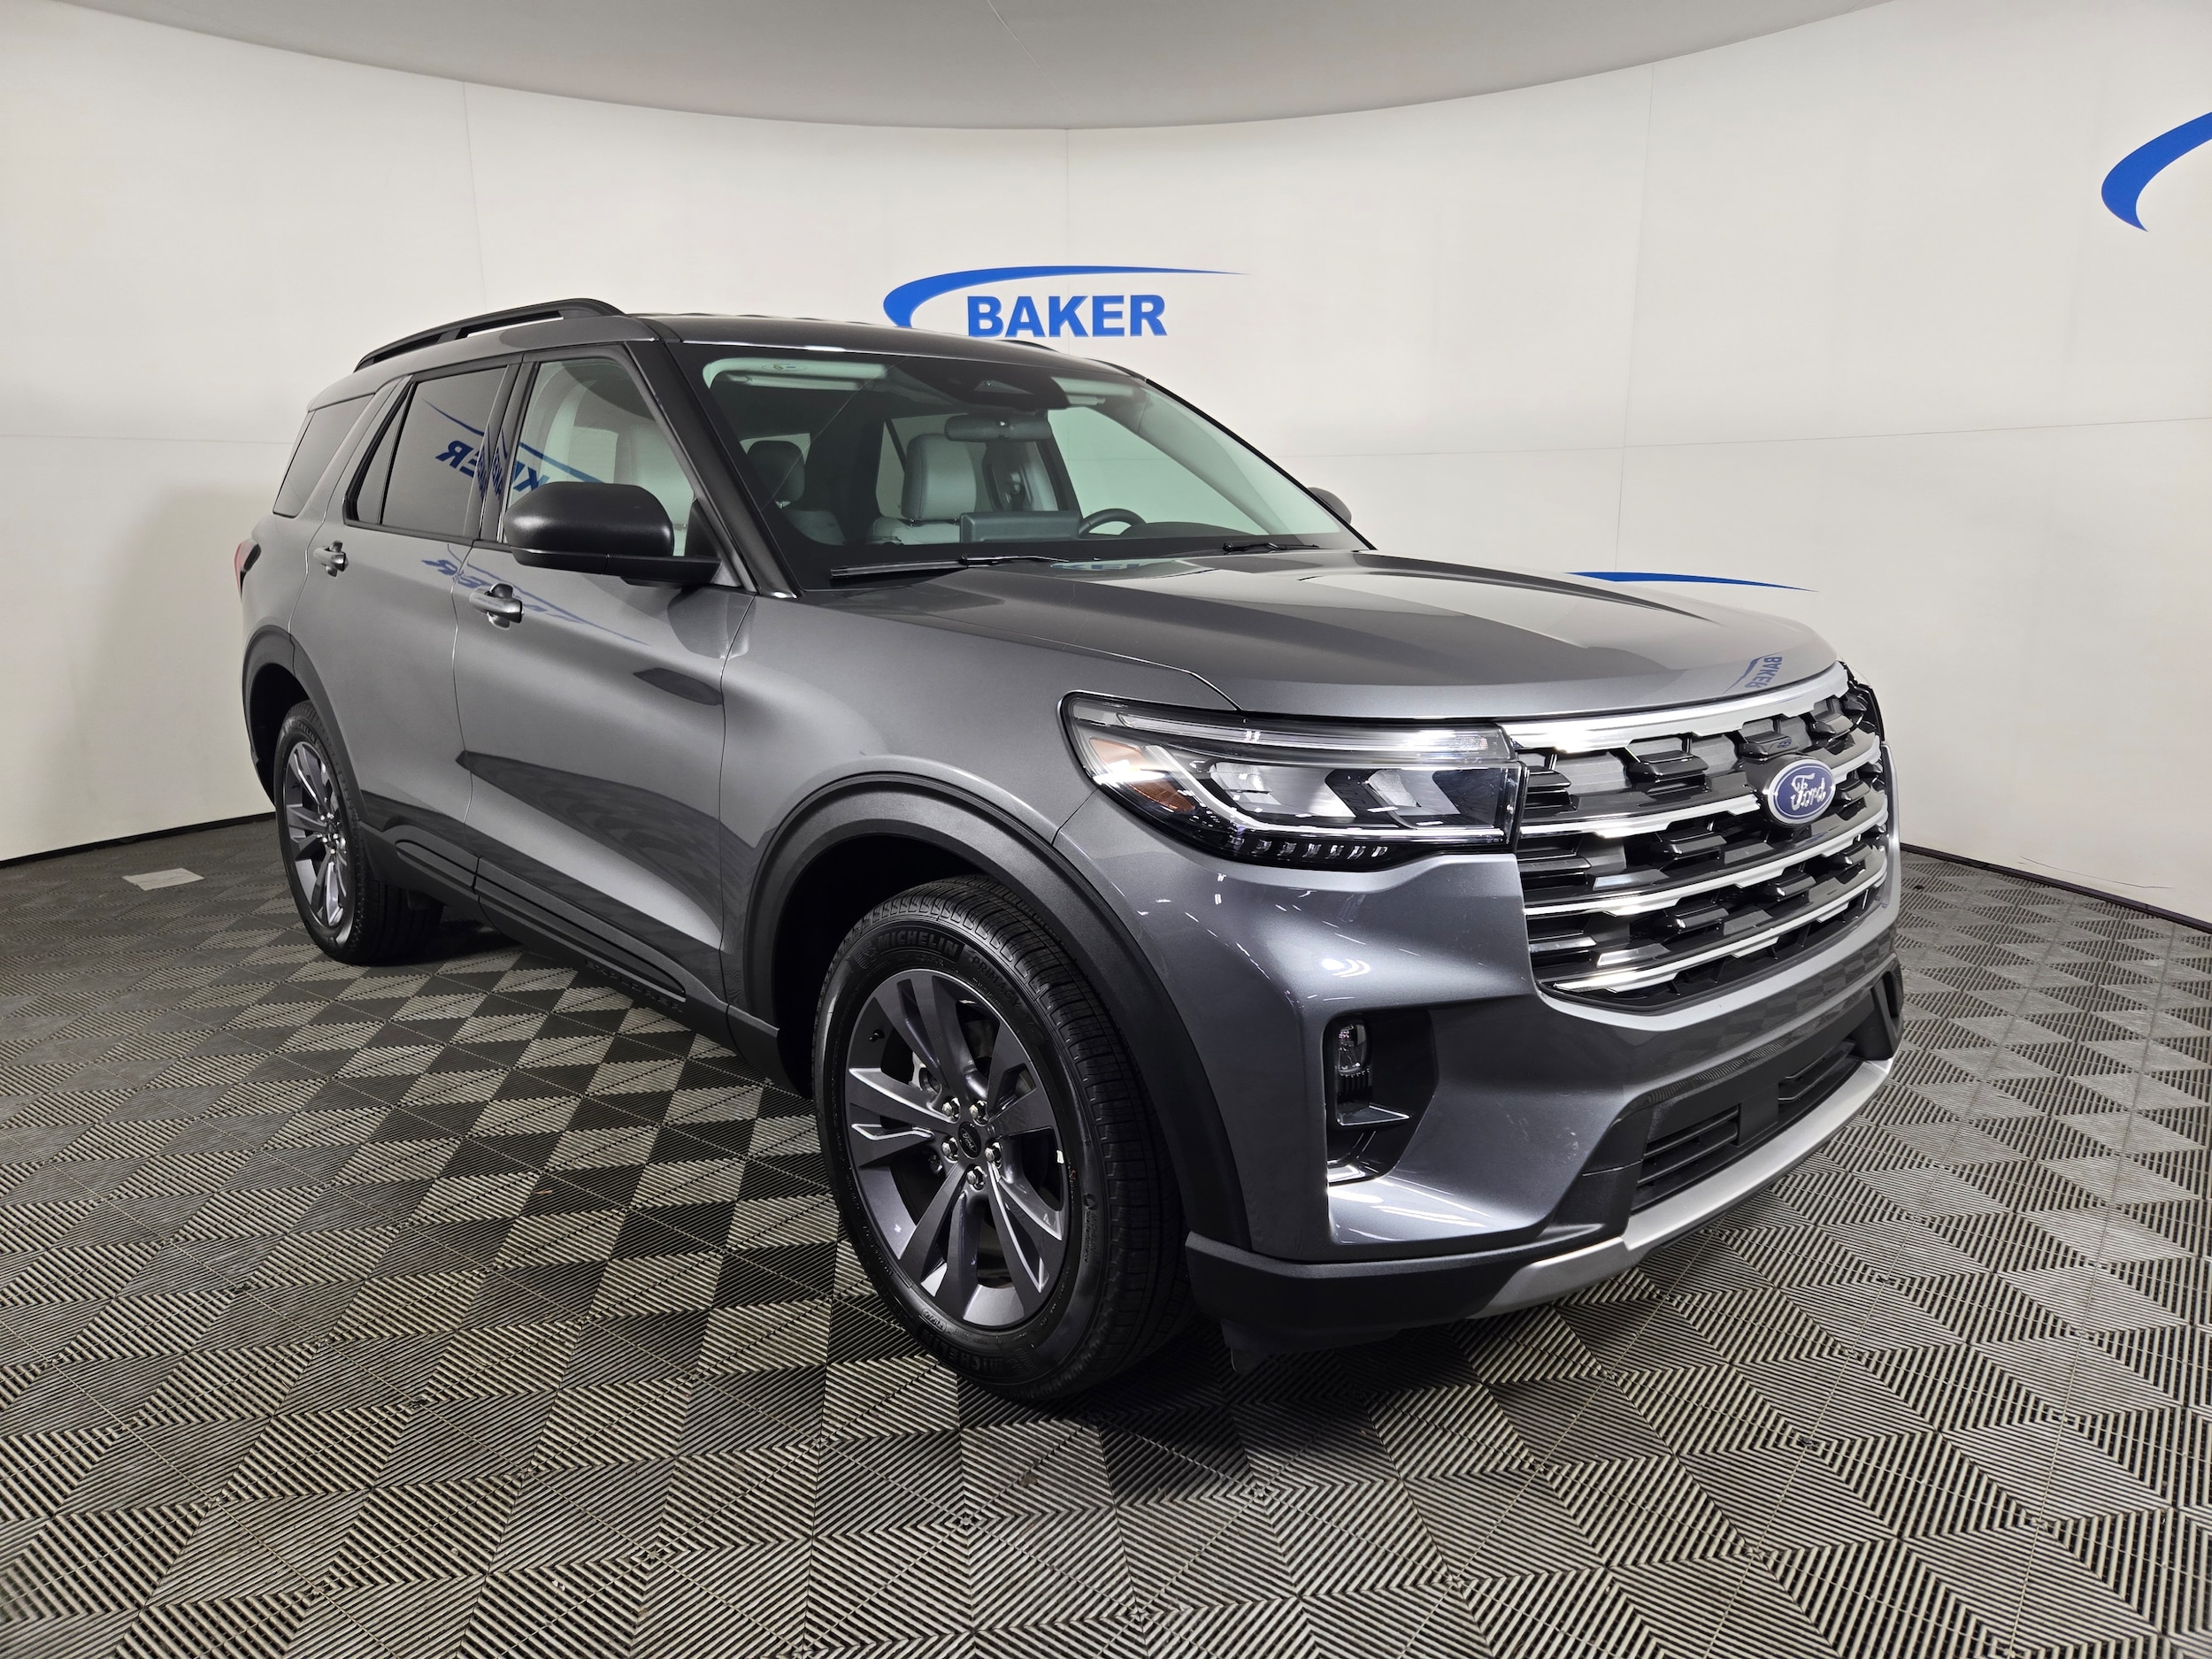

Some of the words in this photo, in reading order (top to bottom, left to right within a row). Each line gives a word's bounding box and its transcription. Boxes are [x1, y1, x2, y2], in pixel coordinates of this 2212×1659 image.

[967, 295, 1168, 338] BAKER
[1790, 772, 1827, 811] Ford
[877, 929, 960, 957] MICHELIN
[585, 960, 684, 1013] EXPLORER
[971, 955, 1022, 1007] PRIMACY
